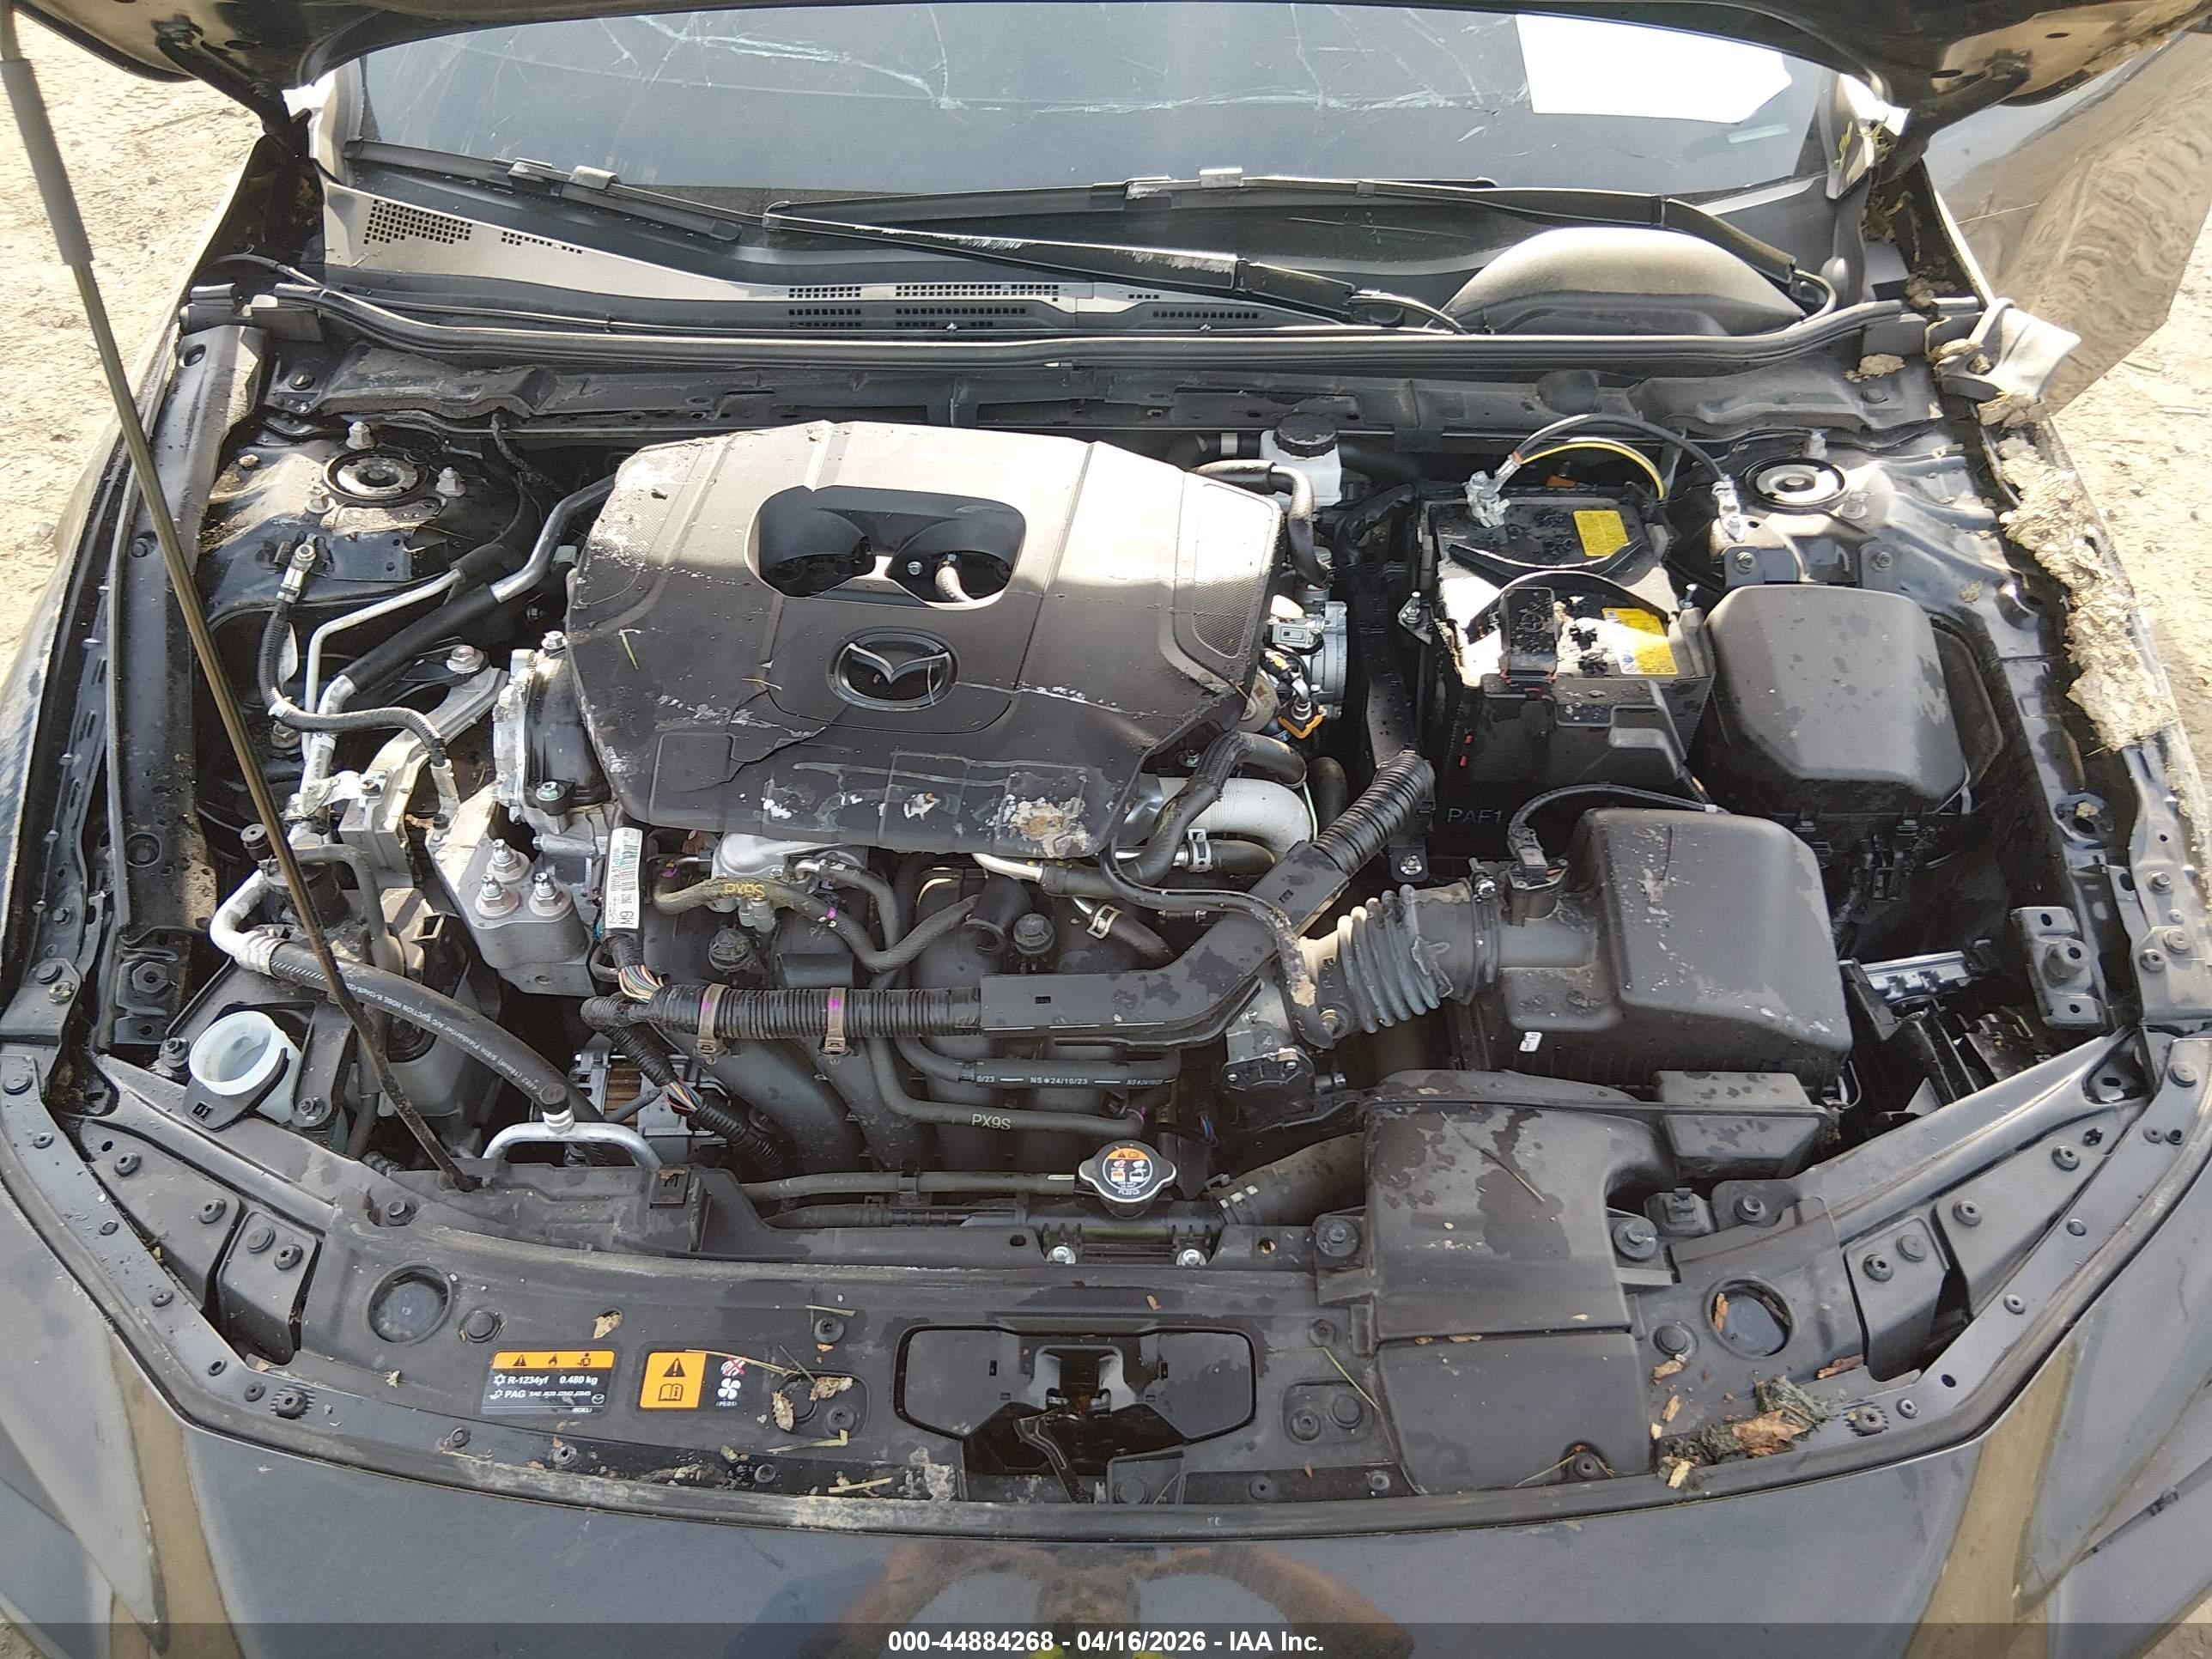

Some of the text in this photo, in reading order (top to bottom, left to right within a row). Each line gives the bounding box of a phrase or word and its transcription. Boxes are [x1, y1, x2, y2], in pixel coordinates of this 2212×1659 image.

[1446, 808, 1503, 823] PAF1
[971, 1113, 1012, 1130] PX9S
[507, 1376, 599, 1386] R-1234yf 0.480 kg
[504, 1389, 526, 1398] PAG
